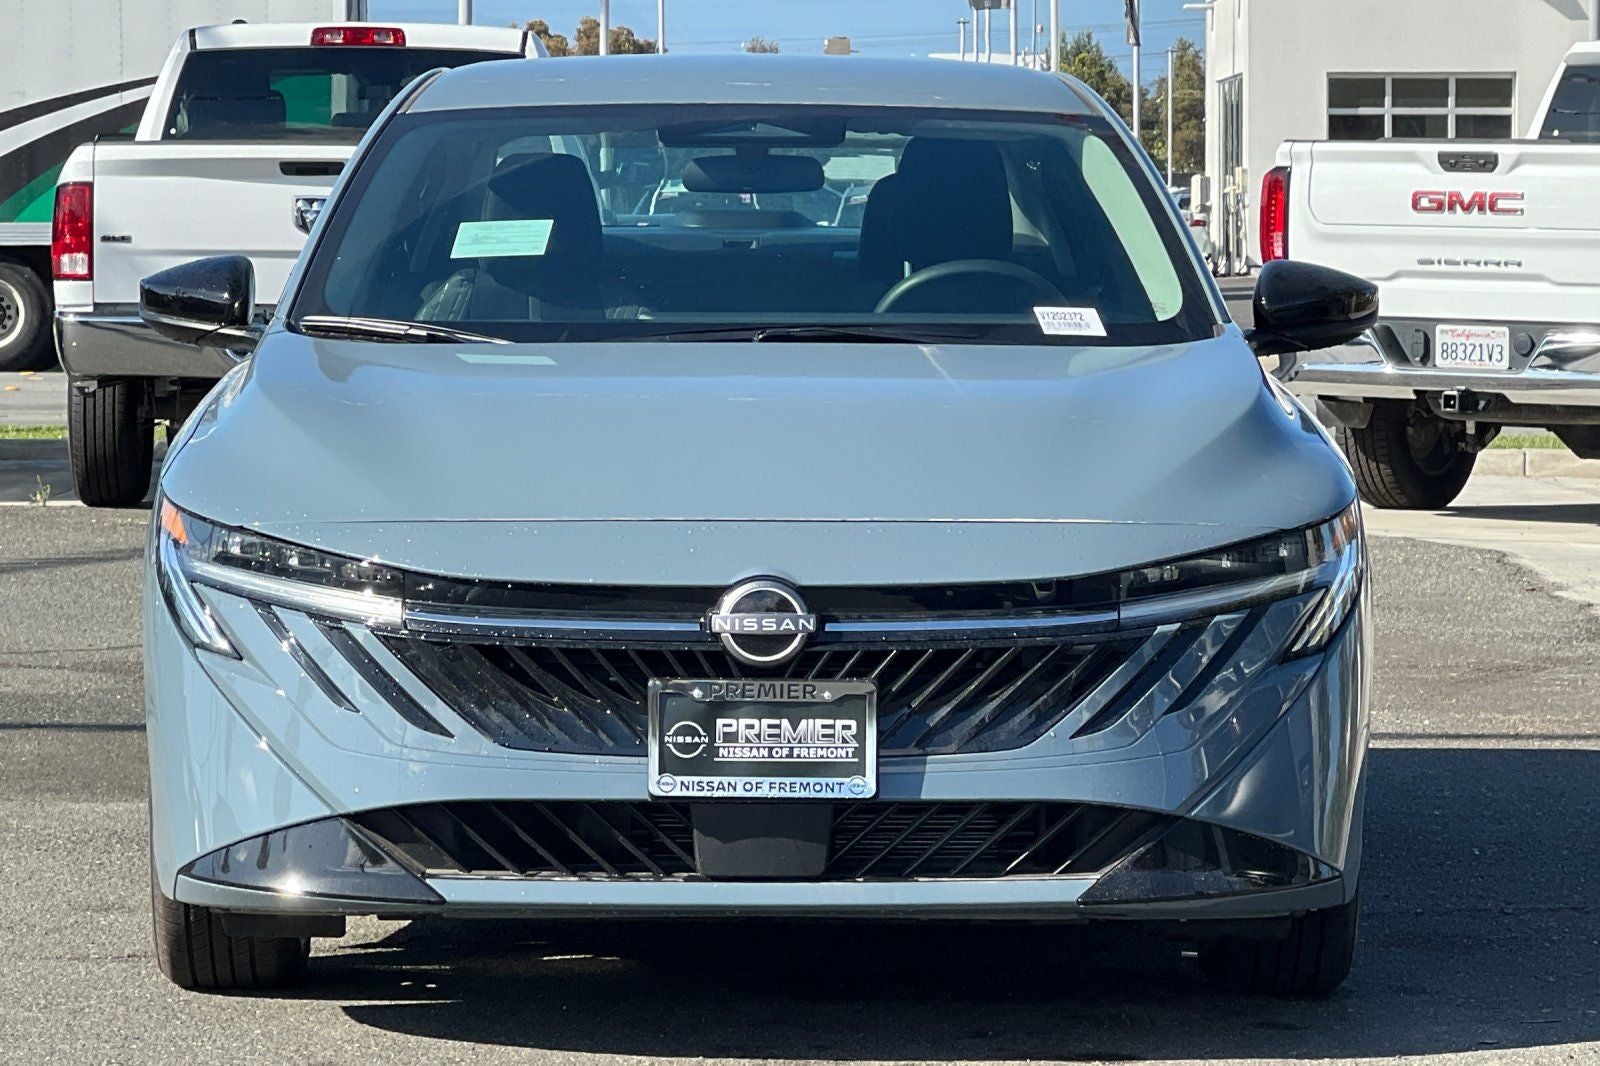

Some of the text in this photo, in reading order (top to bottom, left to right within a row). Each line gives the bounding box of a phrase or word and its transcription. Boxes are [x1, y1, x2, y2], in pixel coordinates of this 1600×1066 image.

[1411, 190, 1524, 216] GMC
[1441, 342, 1503, 362] 88321V3
[714, 617, 815, 631] NISSAN
[709, 683, 817, 700] PREMIER
[715, 718, 857, 744] PREMIER
[664, 735, 709, 743] NISSAN
[718, 747, 855, 758] NISSAN OF FREMONT
[680, 780, 737, 792] NISSAN
[743, 781, 762, 792] OF
[768, 782, 845, 793] FREMONT
